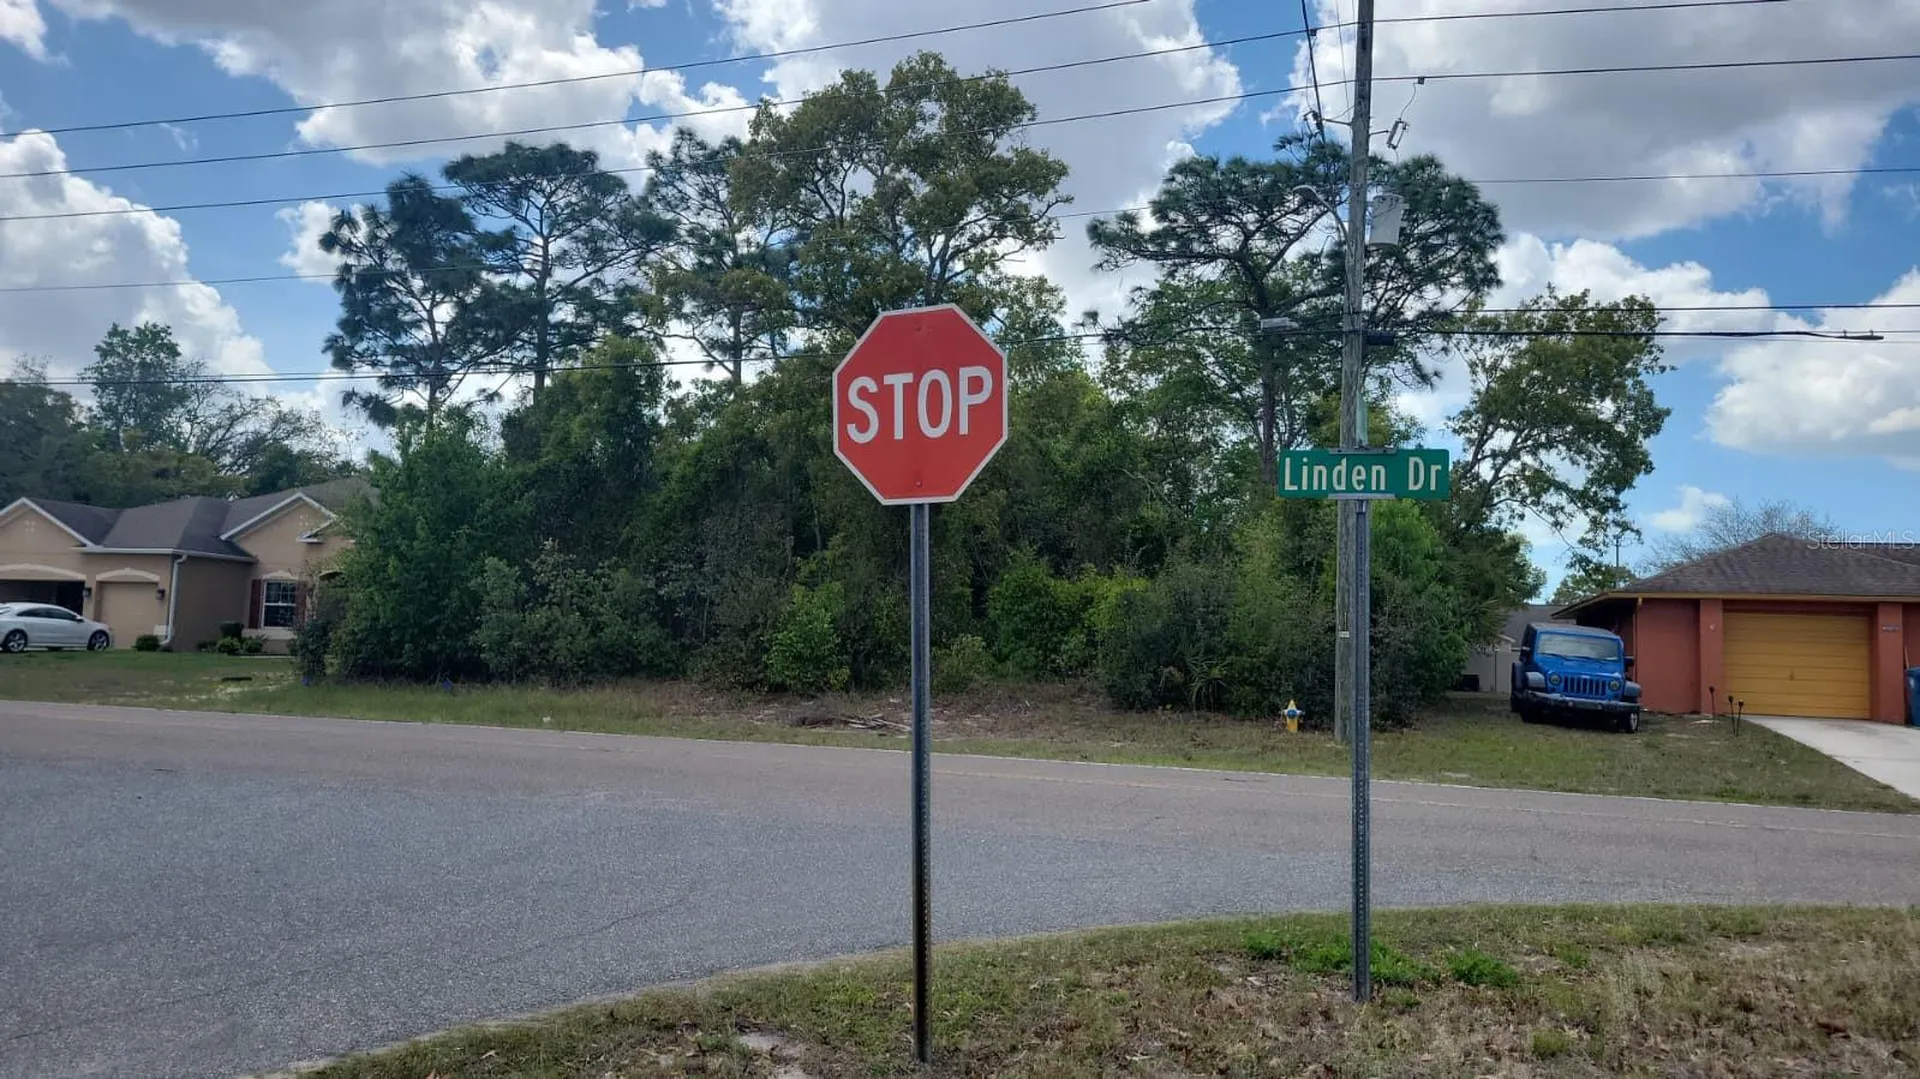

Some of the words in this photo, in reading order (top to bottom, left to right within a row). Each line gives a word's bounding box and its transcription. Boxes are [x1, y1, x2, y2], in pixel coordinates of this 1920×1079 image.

[846, 365, 993, 444] STOP
[1284, 456, 1386, 491] Linden
[1408, 456, 1442, 491] Dr
